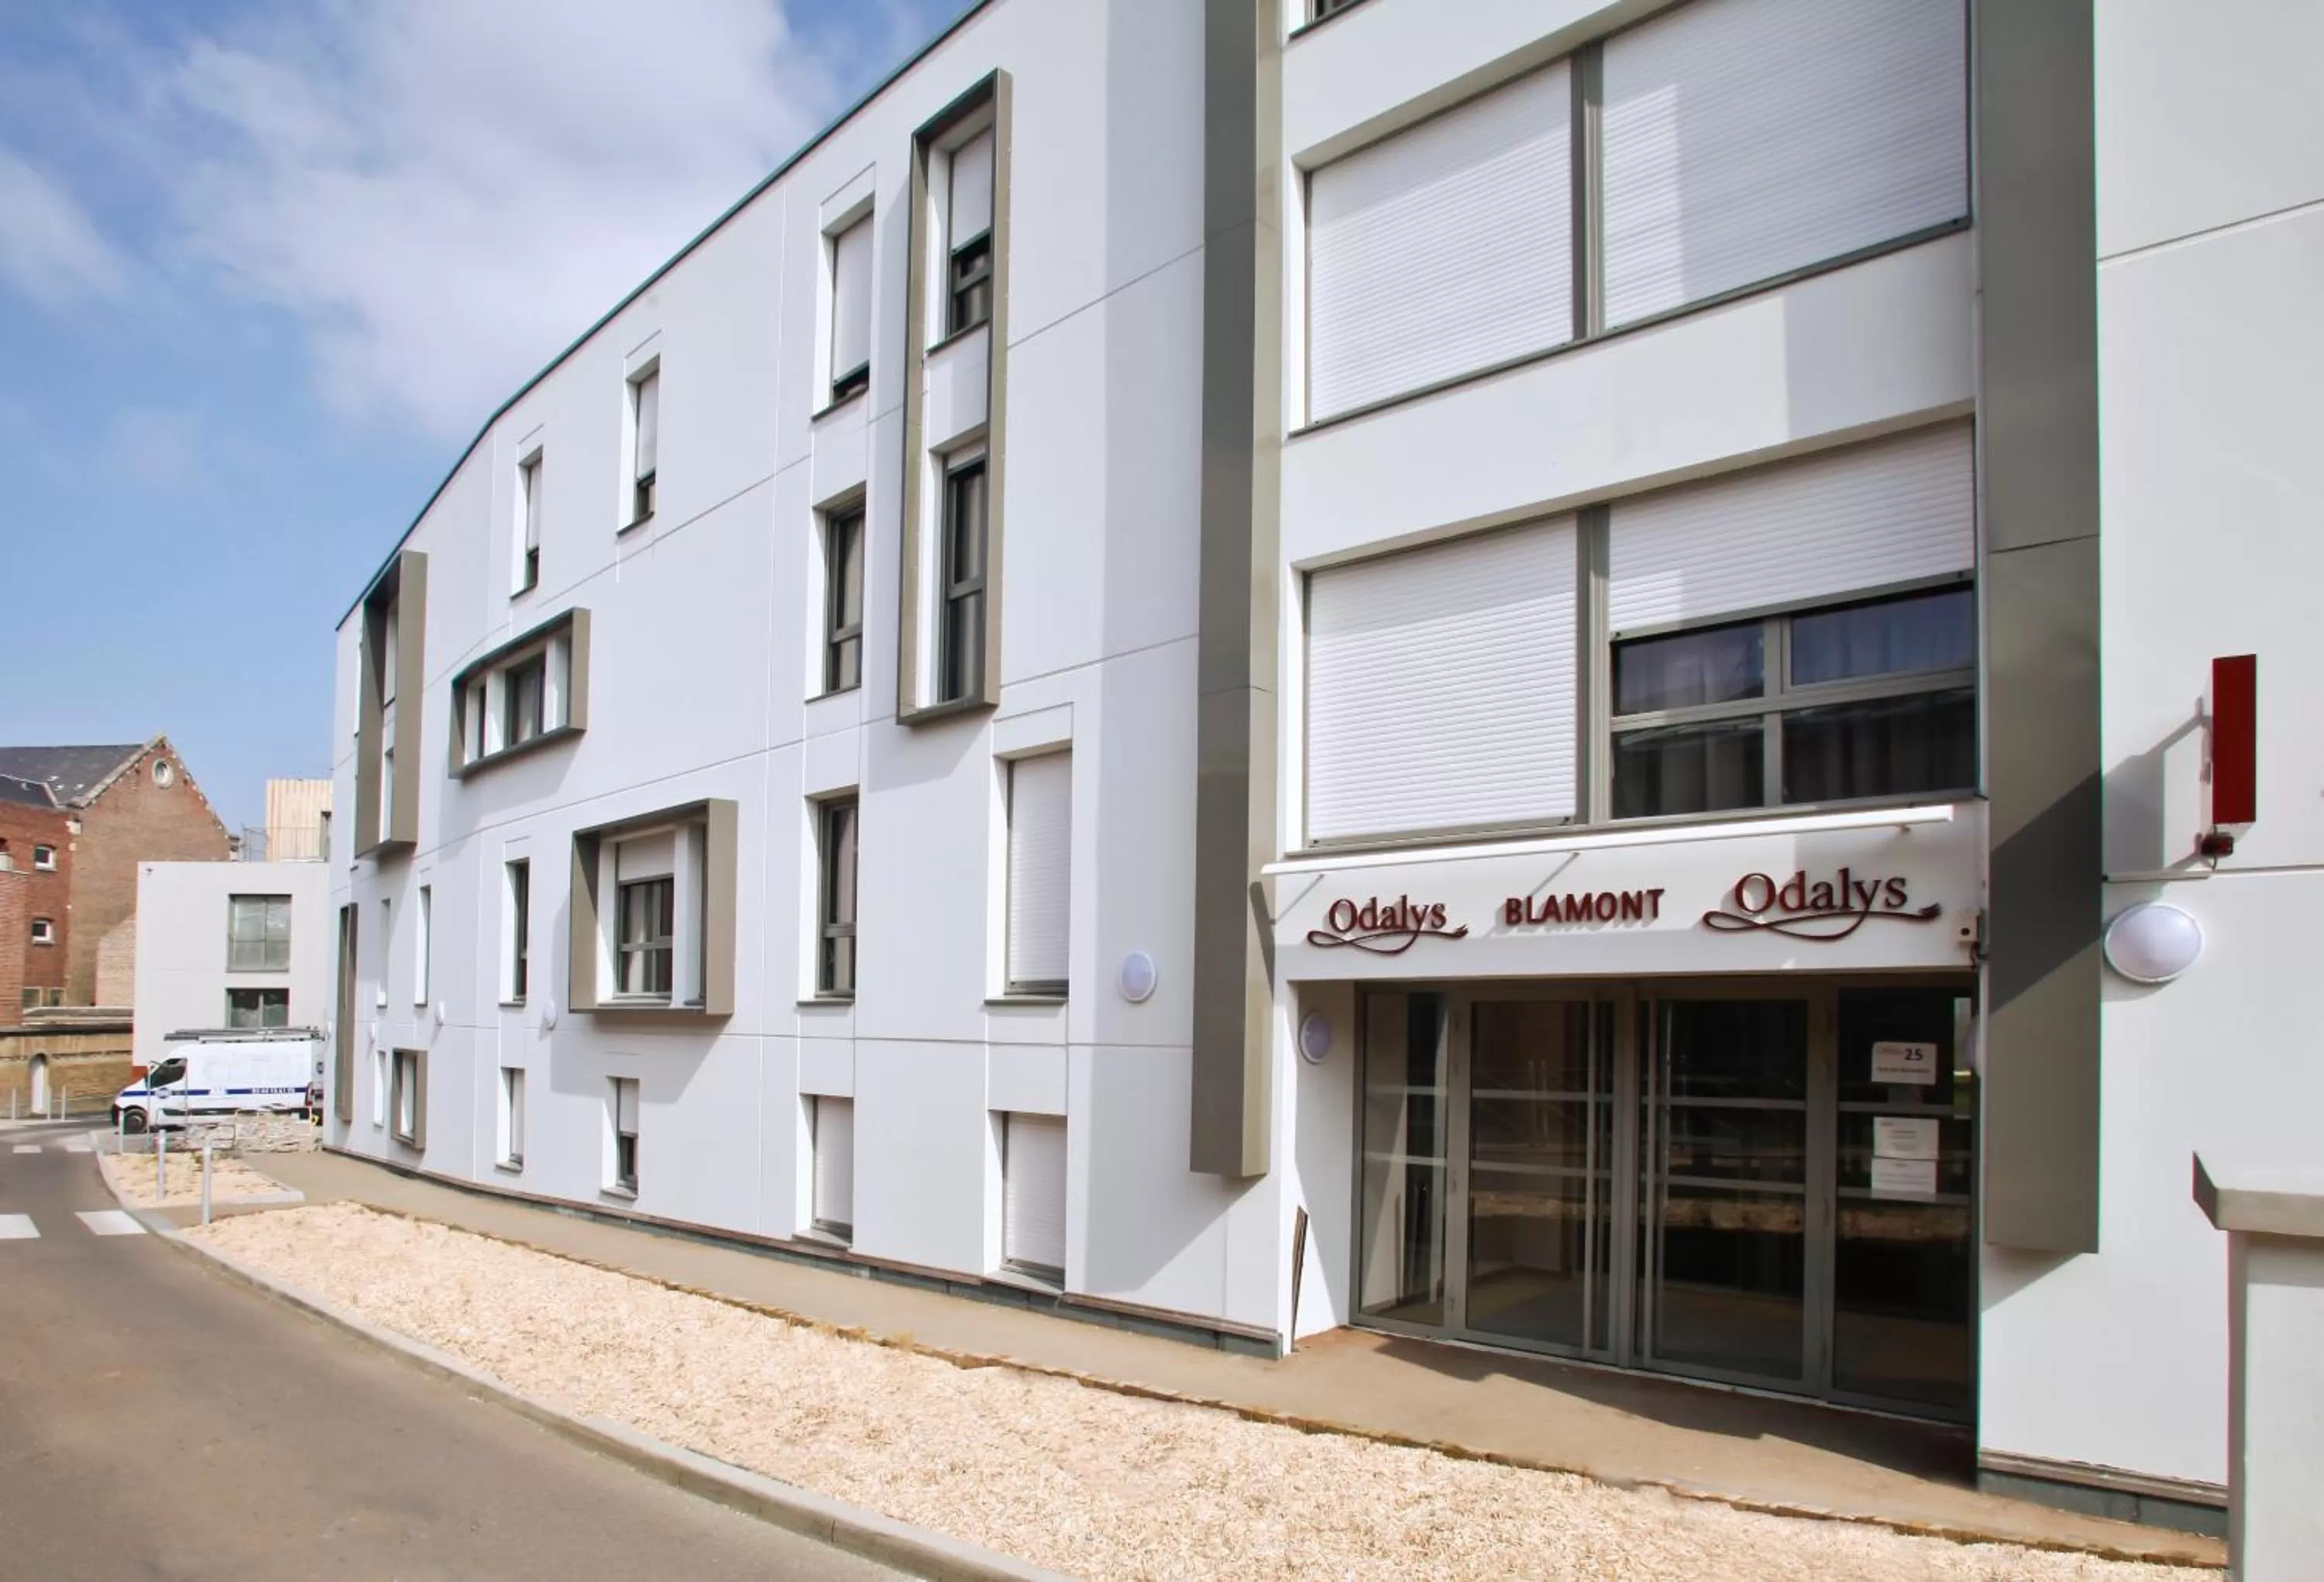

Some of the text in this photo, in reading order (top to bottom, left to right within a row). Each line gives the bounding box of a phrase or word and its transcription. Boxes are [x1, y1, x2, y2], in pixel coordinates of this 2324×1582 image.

[1328, 894, 1447, 955] Odalys
[1505, 889, 1666, 927] BLAMONT
[1734, 868, 1909, 941] Odalys
[1904, 1048, 1923, 1061] 25
